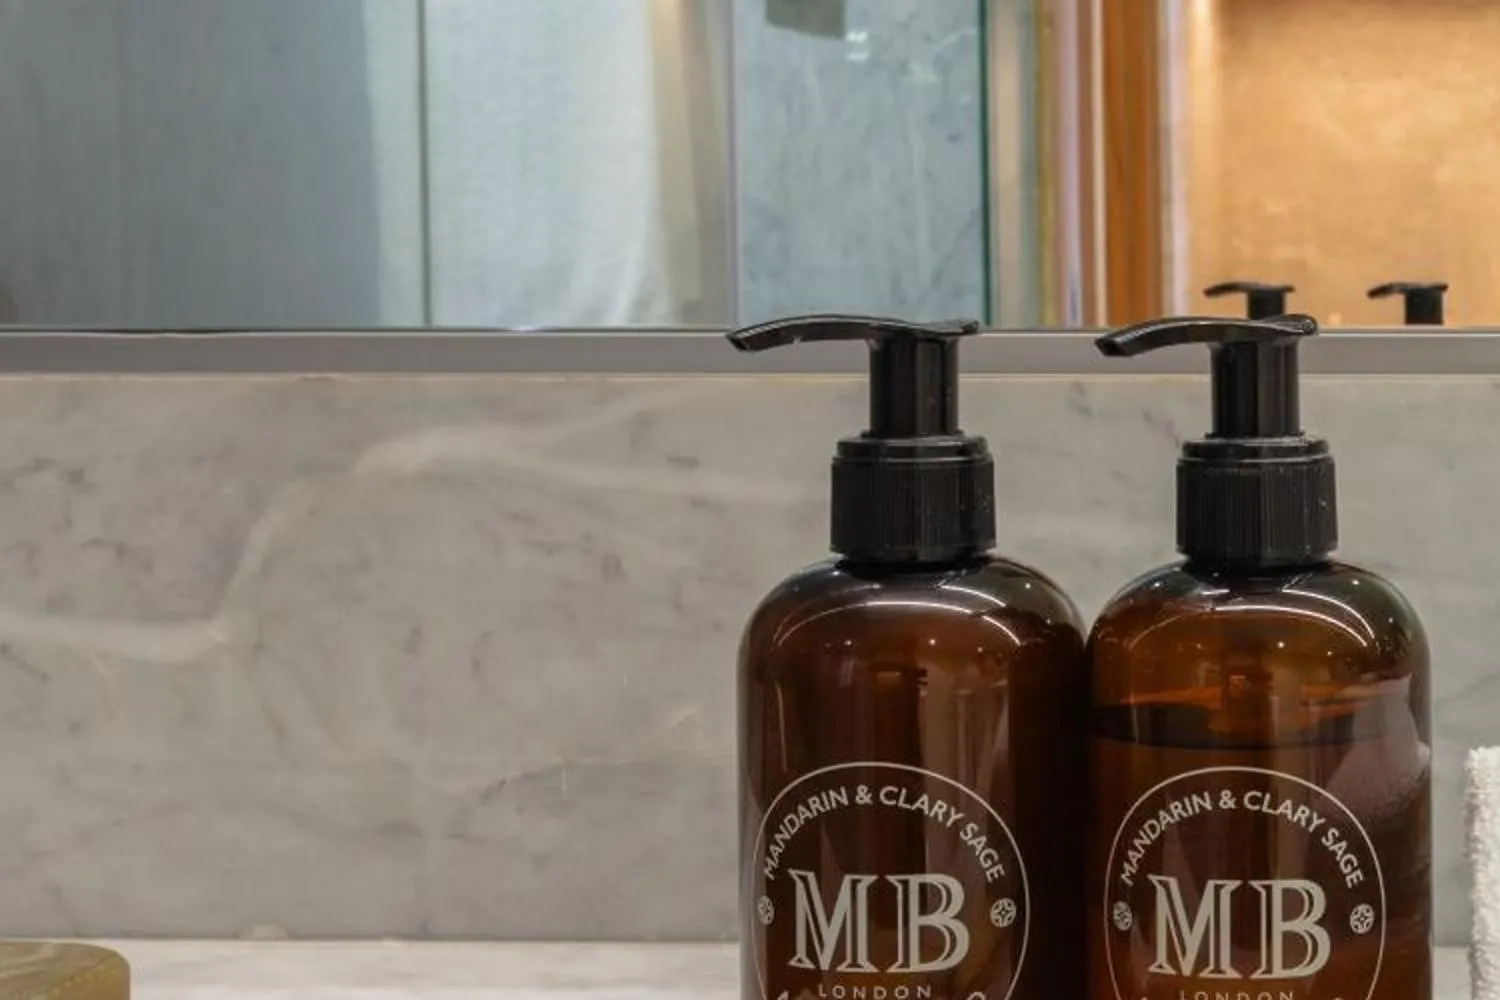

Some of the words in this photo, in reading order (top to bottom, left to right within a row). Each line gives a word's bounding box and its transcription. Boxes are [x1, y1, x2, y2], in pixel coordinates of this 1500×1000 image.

[765, 786, 849, 880] MANDARIN
[855, 784, 873, 805] &
[880, 785, 963, 828] CLARY
[959, 822, 1006, 883] SAGE
[1120, 791, 1213, 886] MANDARIN
[1219, 789, 1237, 809] &
[1244, 790, 1326, 834] CLARY
[1321, 828, 1365, 889] SAGE
[788, 868, 970, 973] MB
[818, 984, 931, 1000] LONDON
